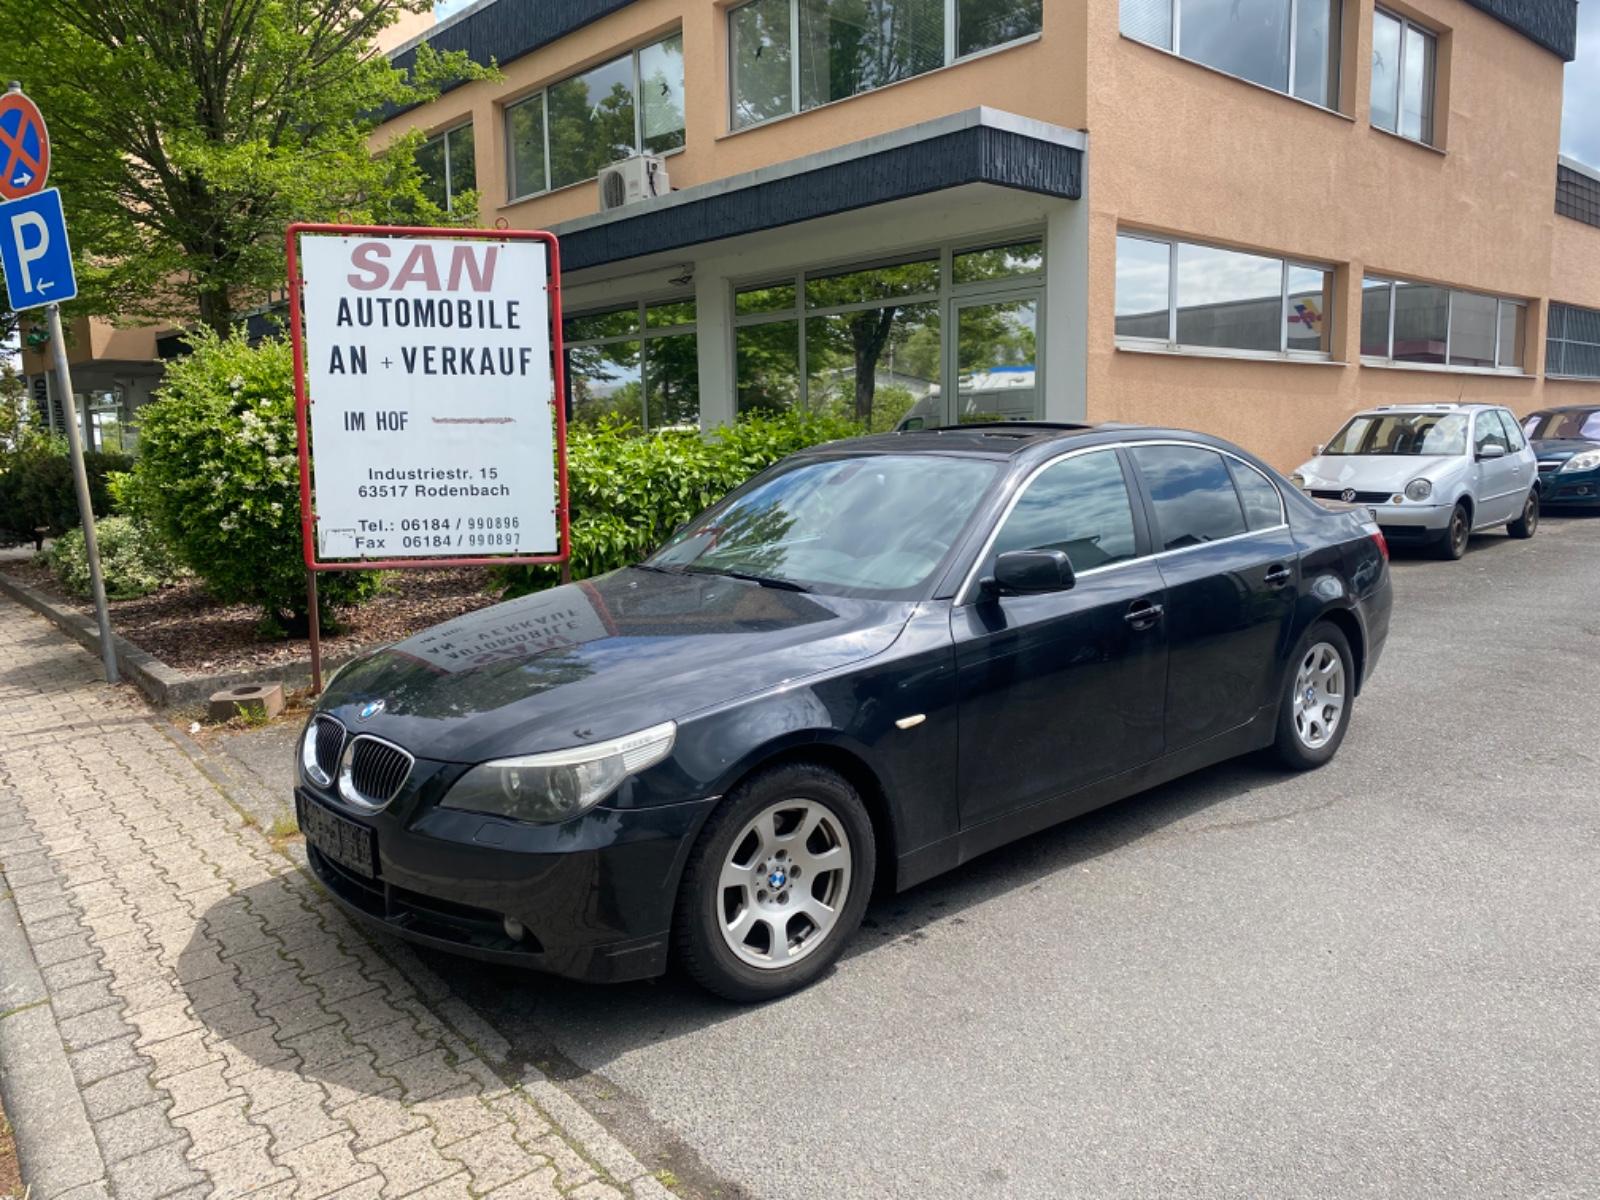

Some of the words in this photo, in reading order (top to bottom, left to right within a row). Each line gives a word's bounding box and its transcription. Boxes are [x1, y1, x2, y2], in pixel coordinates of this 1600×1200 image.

[11, 210, 50, 294] P
[347, 241, 498, 293] SAN
[336, 296, 521, 330] AUTOMOBILE
[328, 344, 368, 375] AN
[381, 356, 394, 369] +
[401, 344, 533, 377] VERKAUF
[343, 410, 366, 432] IM
[376, 410, 409, 432] HOF
[368, 467, 473, 481] Industriestr.
[480, 467, 498, 480] 15
[358, 485, 408, 498] 63517
[415, 484, 510, 497] Rodenbach
[358, 519, 395, 533] Tel.:
[401, 518, 451, 531] 06184
[456, 517, 462, 531] /
[467, 516, 520, 530] 990896
[355, 536, 386, 549] Fax
[402, 535, 452, 548] 06184
[456, 534, 462, 548] /
[468, 533, 521, 547] 990897
